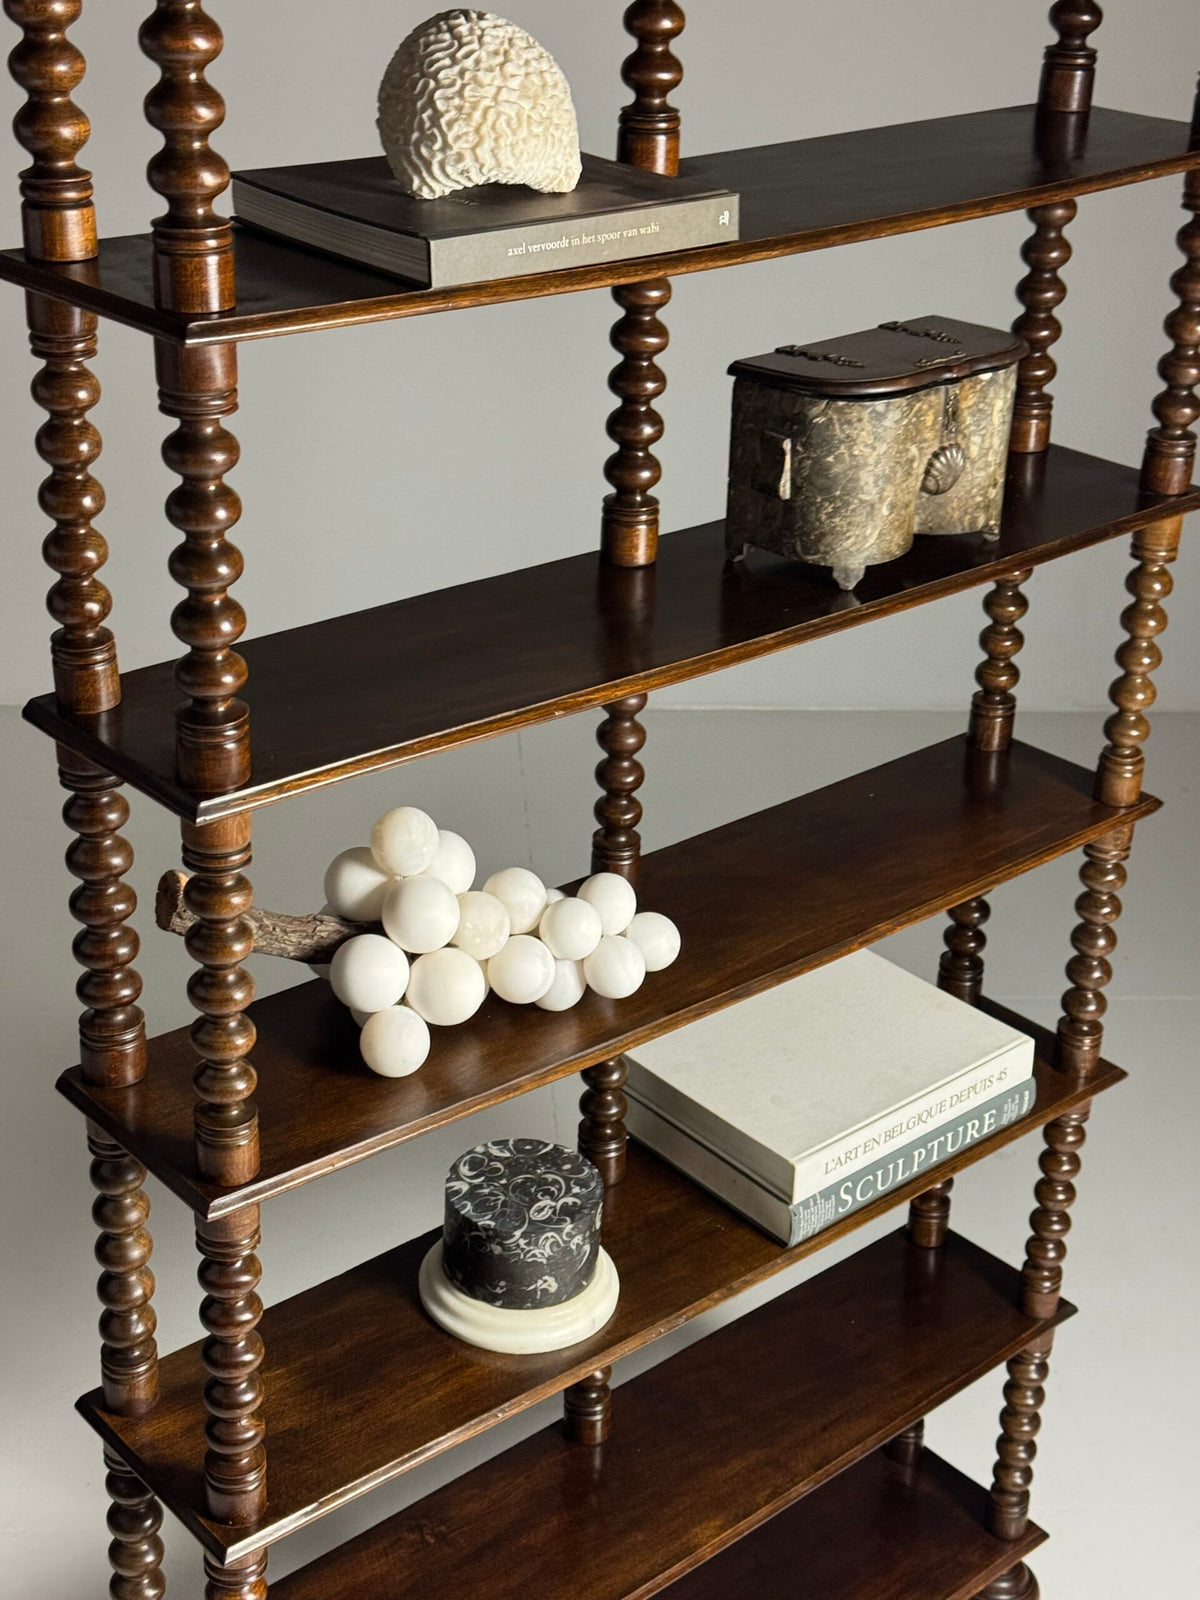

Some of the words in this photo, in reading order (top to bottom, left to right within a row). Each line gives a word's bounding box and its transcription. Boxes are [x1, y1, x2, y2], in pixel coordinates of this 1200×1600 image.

[507, 242, 526, 257] axel
[528, 236, 569, 253] vervoordt
[571, 234, 580, 246] in
[582, 232, 596, 245] het
[597, 231, 621, 244] spoor
[623, 228, 638, 238] van
[639, 222, 660, 234] wabi
[824, 1145, 861, 1175] L'ART
[863, 1133, 882, 1156] EN
[883, 1101, 948, 1144] BELGIQUE
[950, 1075, 994, 1107] DEPUIS
[838, 1109, 996, 1213] SCULPTURE
